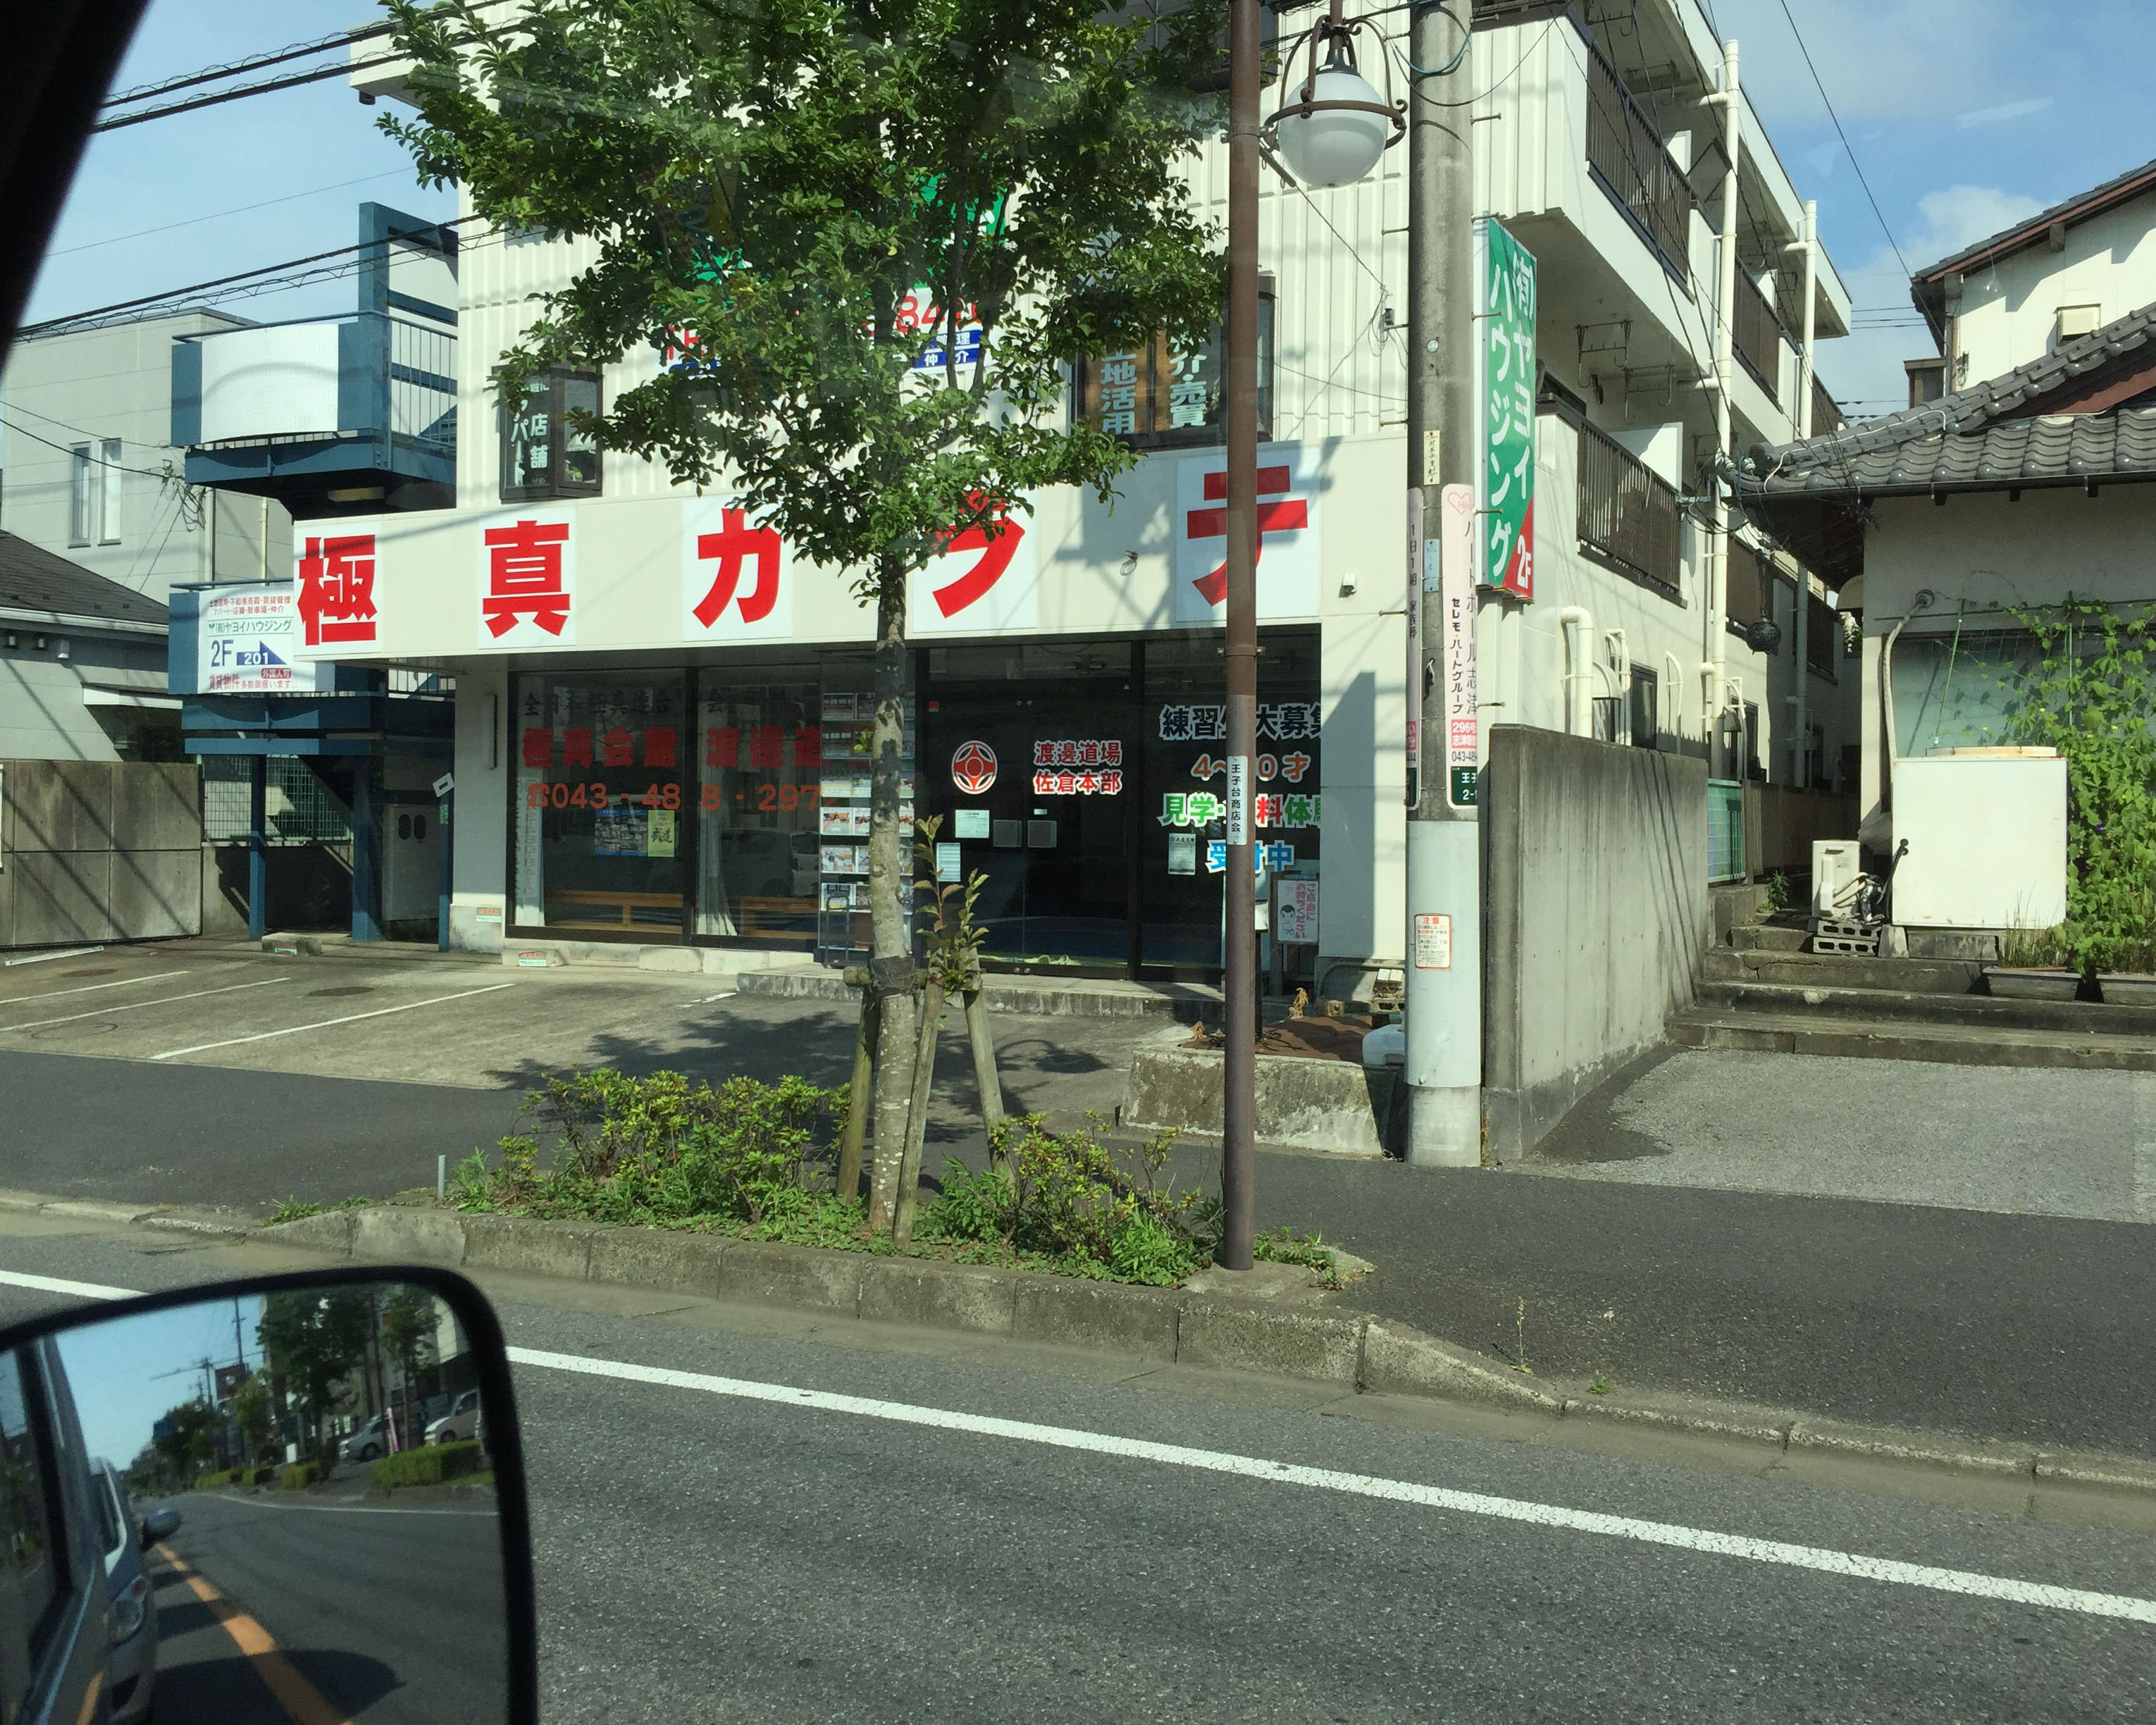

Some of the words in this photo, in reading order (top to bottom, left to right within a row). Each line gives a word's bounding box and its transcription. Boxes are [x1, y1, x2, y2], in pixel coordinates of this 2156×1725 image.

[1490, 264, 1513, 576] ハウジング
[1516, 536, 1531, 590] 2F
[211, 639, 234, 667] 2F
[244, 653, 268, 665] 201
[1033, 769, 1122, 794] 佐倉本部
[1231, 764, 1241, 833] 王子台商店会
